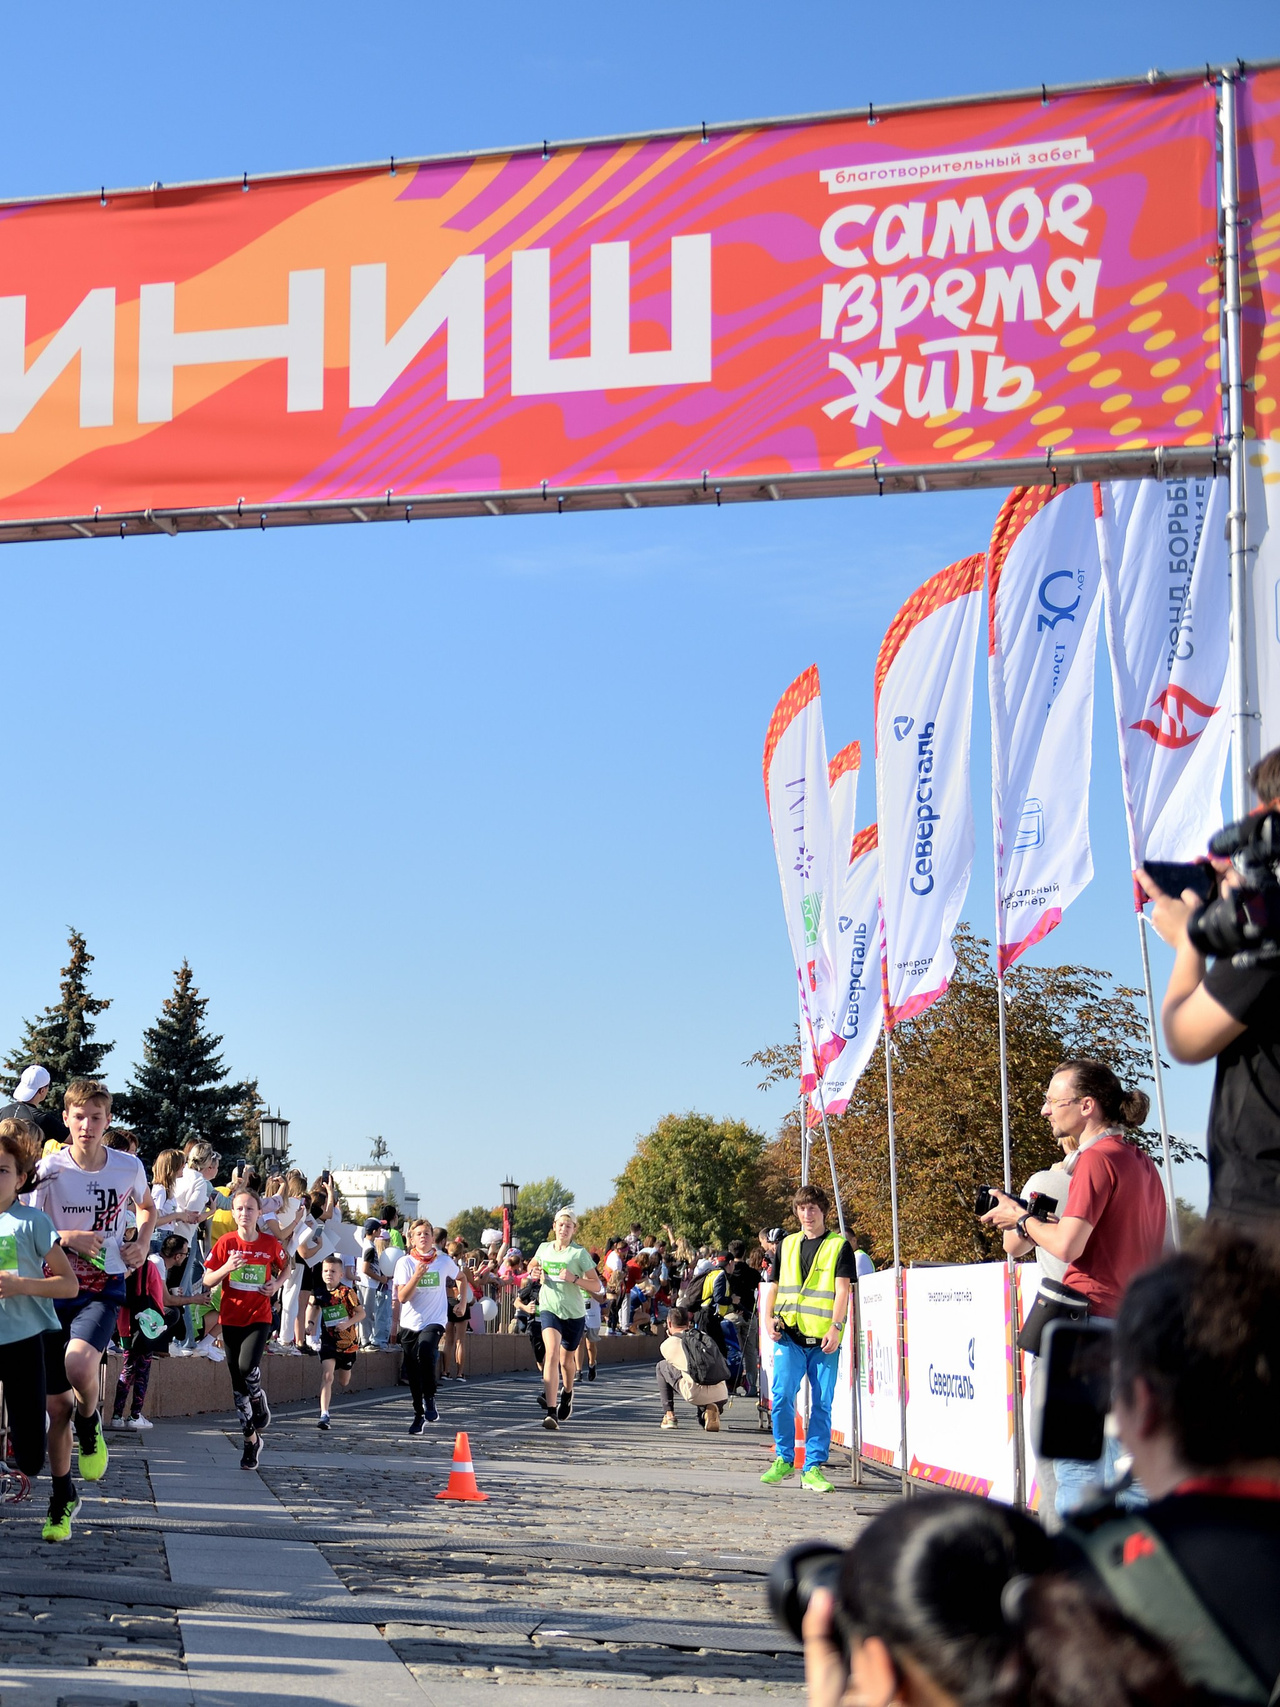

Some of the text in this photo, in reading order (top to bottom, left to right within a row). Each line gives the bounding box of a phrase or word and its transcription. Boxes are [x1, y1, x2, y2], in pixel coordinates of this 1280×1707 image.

[834, 146, 1083, 185] благотворительный забег
[1077, 568, 1086, 592] лет
[1036, 569, 1081, 633] 30
[909, 721, 941, 897] Северсталь
[842, 922, 867, 1040] Северсталь
[62, 1206, 92, 1214] УГЛИЧ
[240, 1272, 259, 1281] 1094
[928, 1363, 975, 1406] Северсталь
